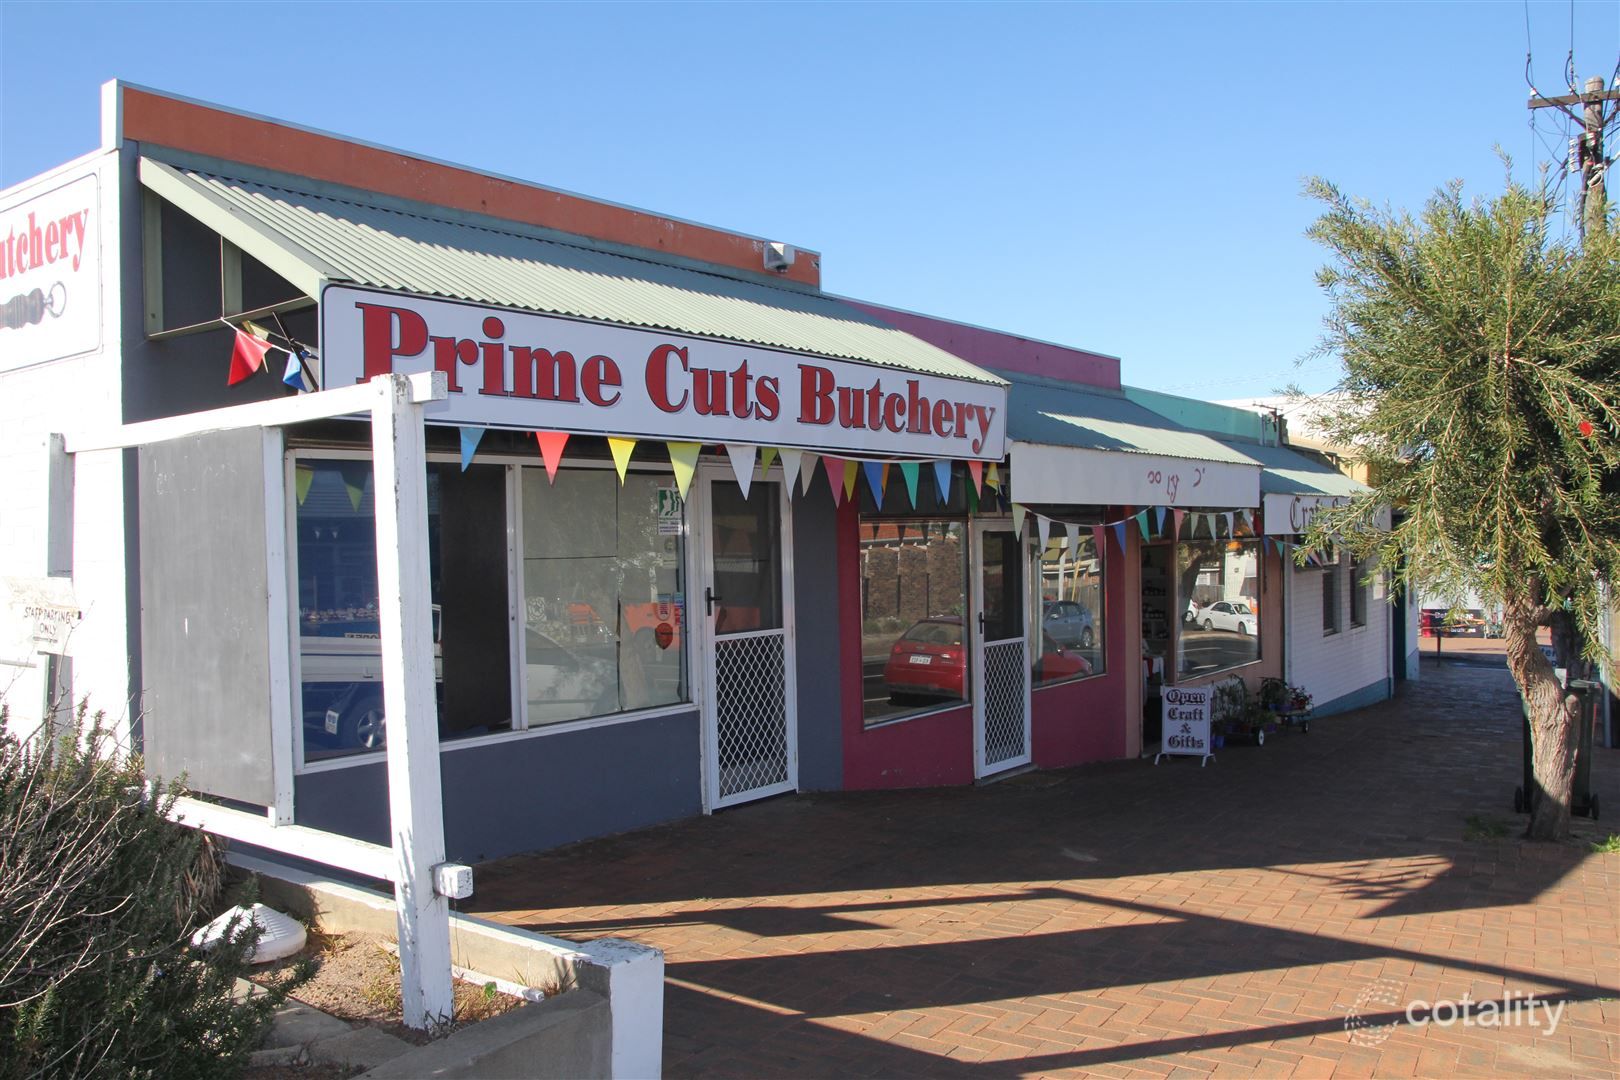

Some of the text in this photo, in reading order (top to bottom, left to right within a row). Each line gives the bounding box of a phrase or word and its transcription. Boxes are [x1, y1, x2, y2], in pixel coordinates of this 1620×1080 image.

[355, 301, 996, 455] Prime Cuts Butchery
[40, 622, 56, 636] ONLY
[1166, 689, 1206, 705] Open
[1168, 707, 1203, 721] Craft
[1180, 722, 1191, 734] &
[1168, 735, 1204, 749] Gifts
